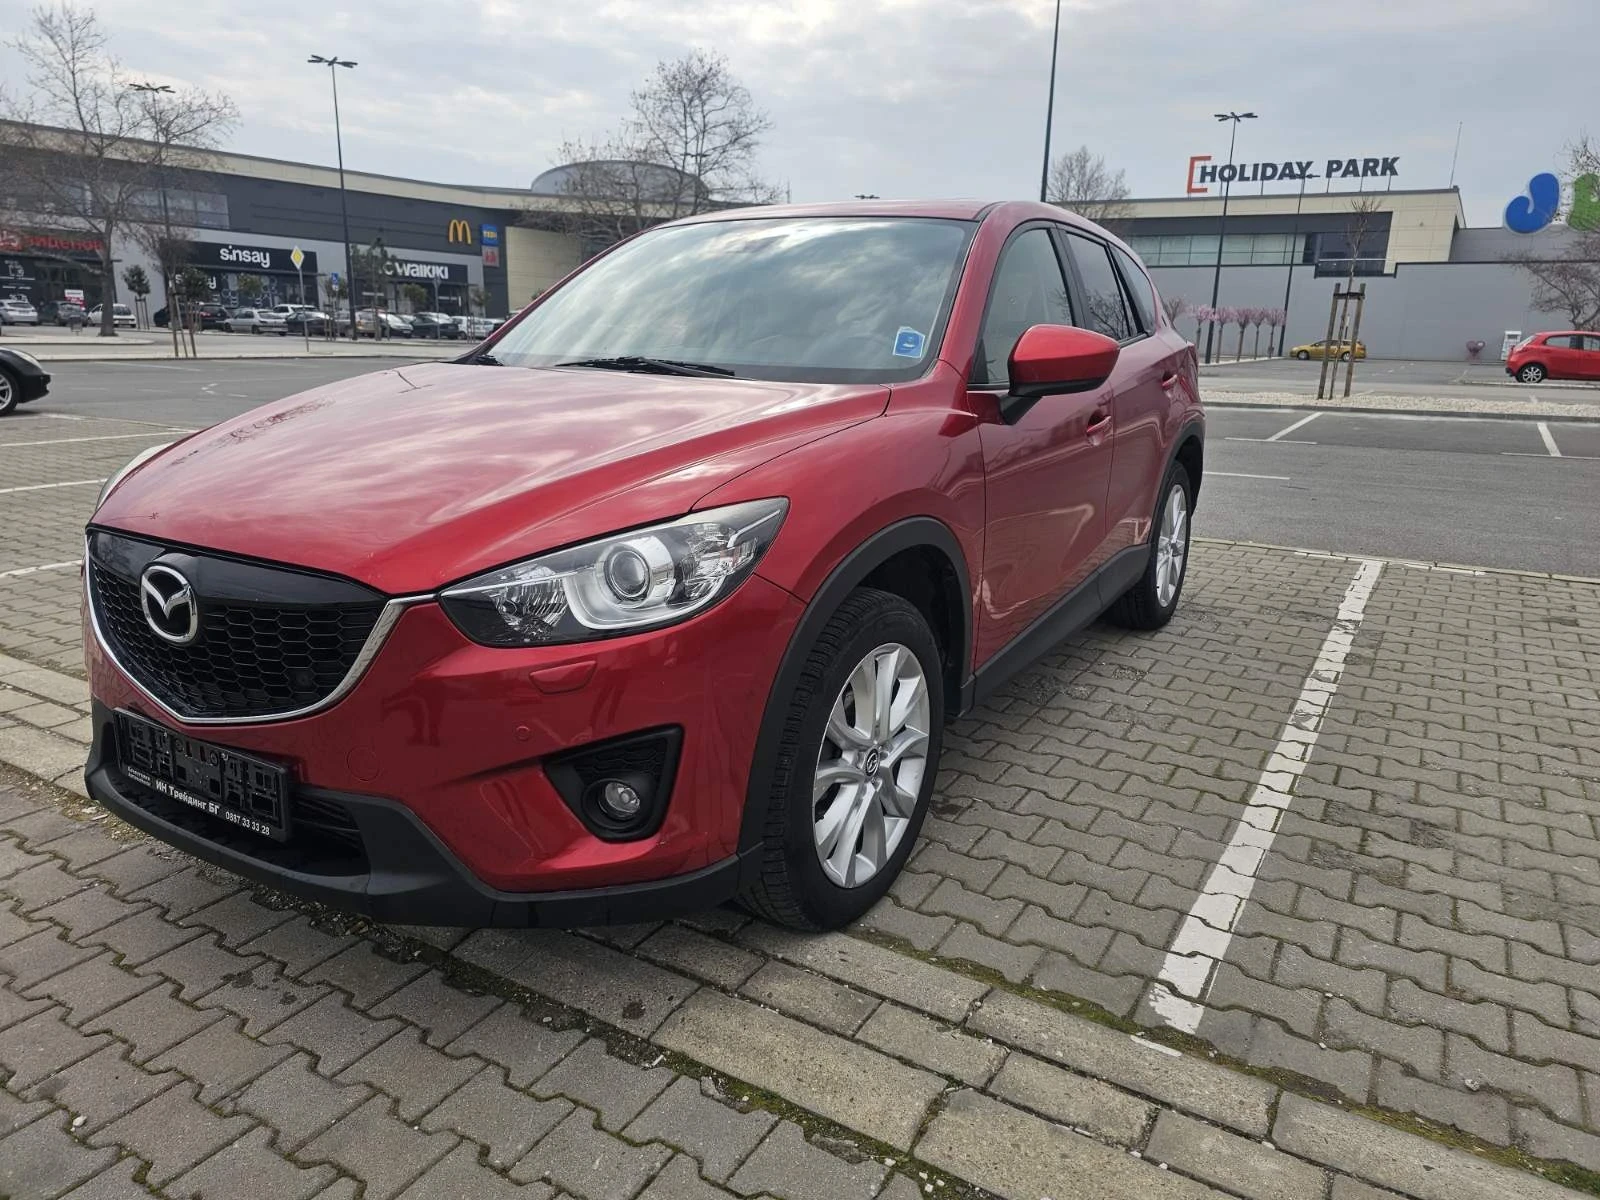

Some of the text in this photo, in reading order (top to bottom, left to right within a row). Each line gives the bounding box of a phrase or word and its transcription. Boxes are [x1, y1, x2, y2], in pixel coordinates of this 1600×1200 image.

[1199, 156, 1400, 184] HOLIDAY PARK
[219, 244, 271, 268] sinsay
[168, 785, 207, 810] Трейдинг
[208, 802, 220, 815] БГ
[251, 821, 260, 832] 33
[261, 825, 270, 836] 28
